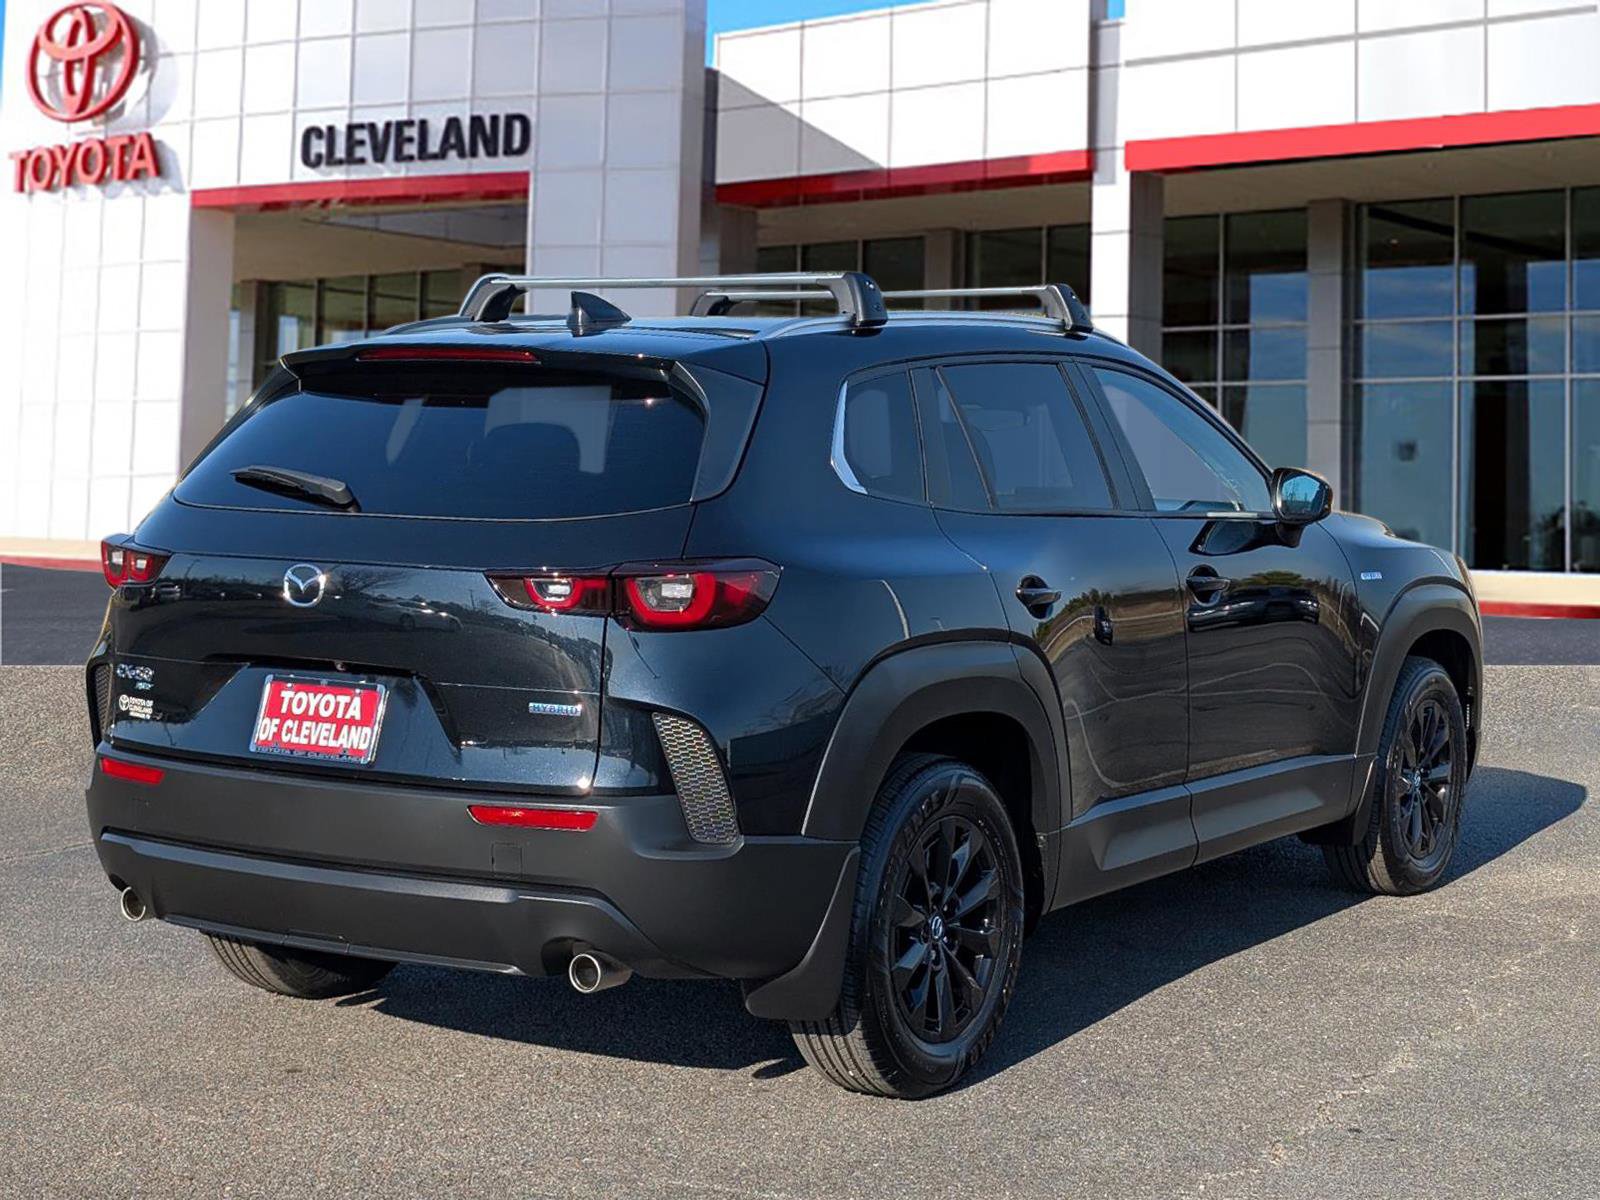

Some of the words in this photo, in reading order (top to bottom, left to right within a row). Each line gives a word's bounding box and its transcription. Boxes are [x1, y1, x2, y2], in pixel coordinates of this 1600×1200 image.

[301, 112, 531, 168] CLEVELAND
[9, 132, 161, 193] TOYOTA
[280, 690, 362, 720] TOYOTA
[530, 703, 580, 715] HYBRID
[259, 717, 280, 741] OF
[282, 719, 371, 750] CLEVELAND
